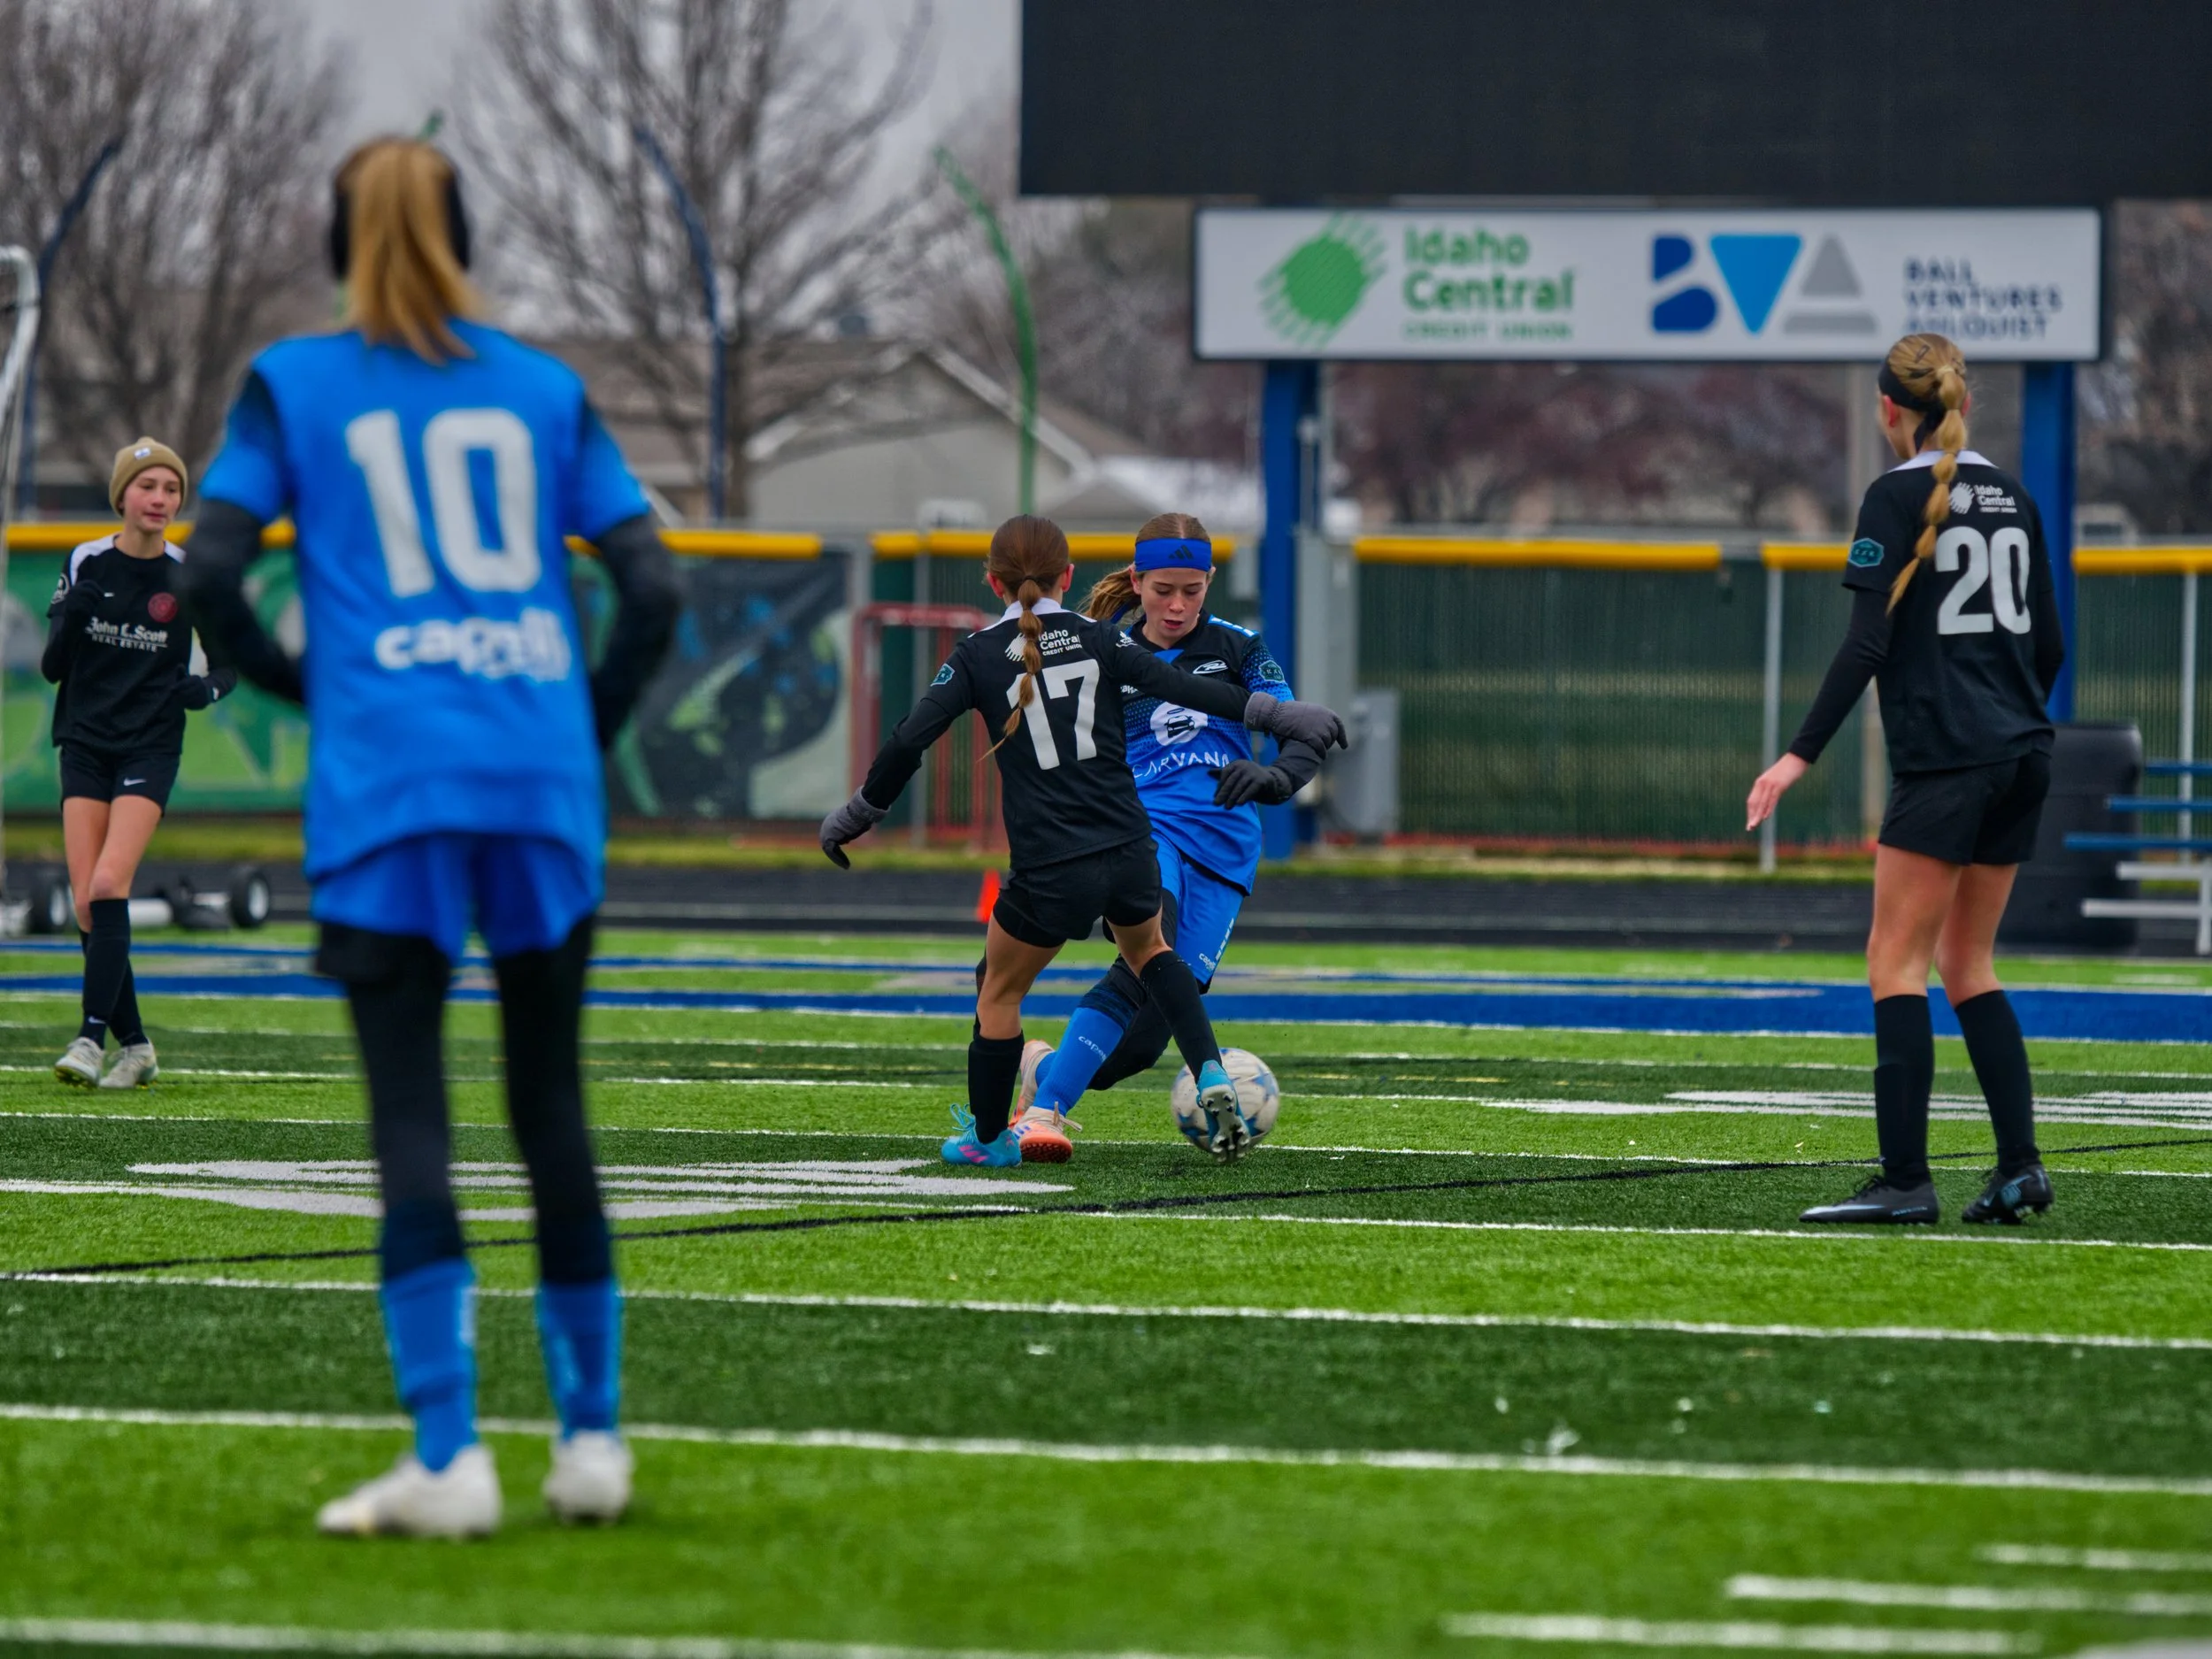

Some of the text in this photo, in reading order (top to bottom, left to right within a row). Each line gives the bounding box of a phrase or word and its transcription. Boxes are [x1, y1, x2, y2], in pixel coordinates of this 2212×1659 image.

[1404, 227, 1531, 265] Idaho
[1903, 256, 1973, 283] BALL
[1402, 268, 1574, 311] Central
[1904, 285, 2063, 312] VENTURES
[344, 407, 542, 598] 10
[1974, 484, 2003, 496] Idaho
[1978, 495, 2016, 506] Central
[1935, 526, 2032, 635] 20
[85, 616, 119, 635] John
[134, 625, 168, 643] Scott
[1039, 629, 1069, 641] Idaho
[1040, 634, 1081, 650] Central
[91, 634, 157, 653] REAL ESTATE
[1042, 647, 1064, 657] CREDIT
[1005, 658, 1101, 771] 17
